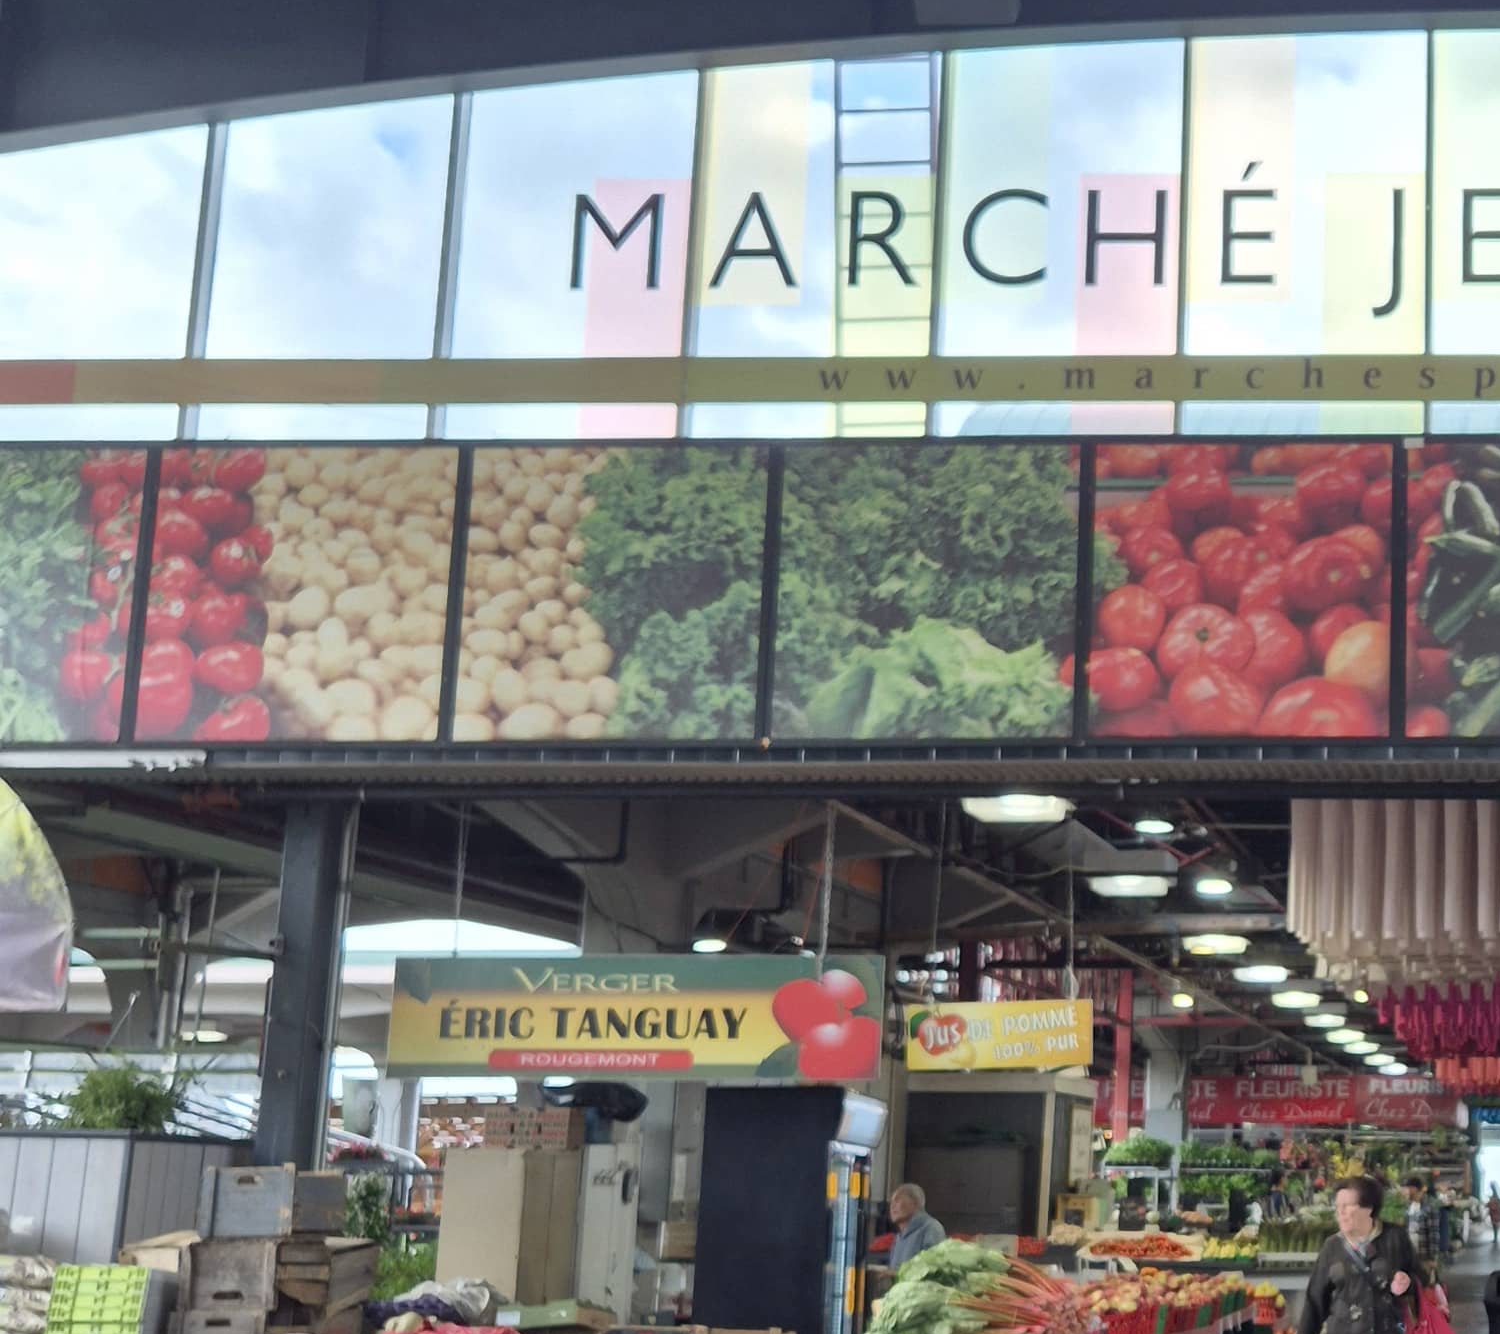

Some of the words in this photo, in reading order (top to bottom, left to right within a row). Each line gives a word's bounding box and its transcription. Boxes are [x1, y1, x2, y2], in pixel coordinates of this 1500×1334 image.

[570, 161, 1278, 290] MARCHÉ
[513, 967, 680, 993] VERGER
[439, 999, 535, 1040] ÉRIC
[551, 1006, 748, 1040] TANGUAY
[1002, 1006, 1078, 1036] POMME
[1046, 1034, 1079, 1053] PUR
[520, 1052, 661, 1068] ROUGEMONT
[1234, 1079, 1351, 1100] FLEURISTE
